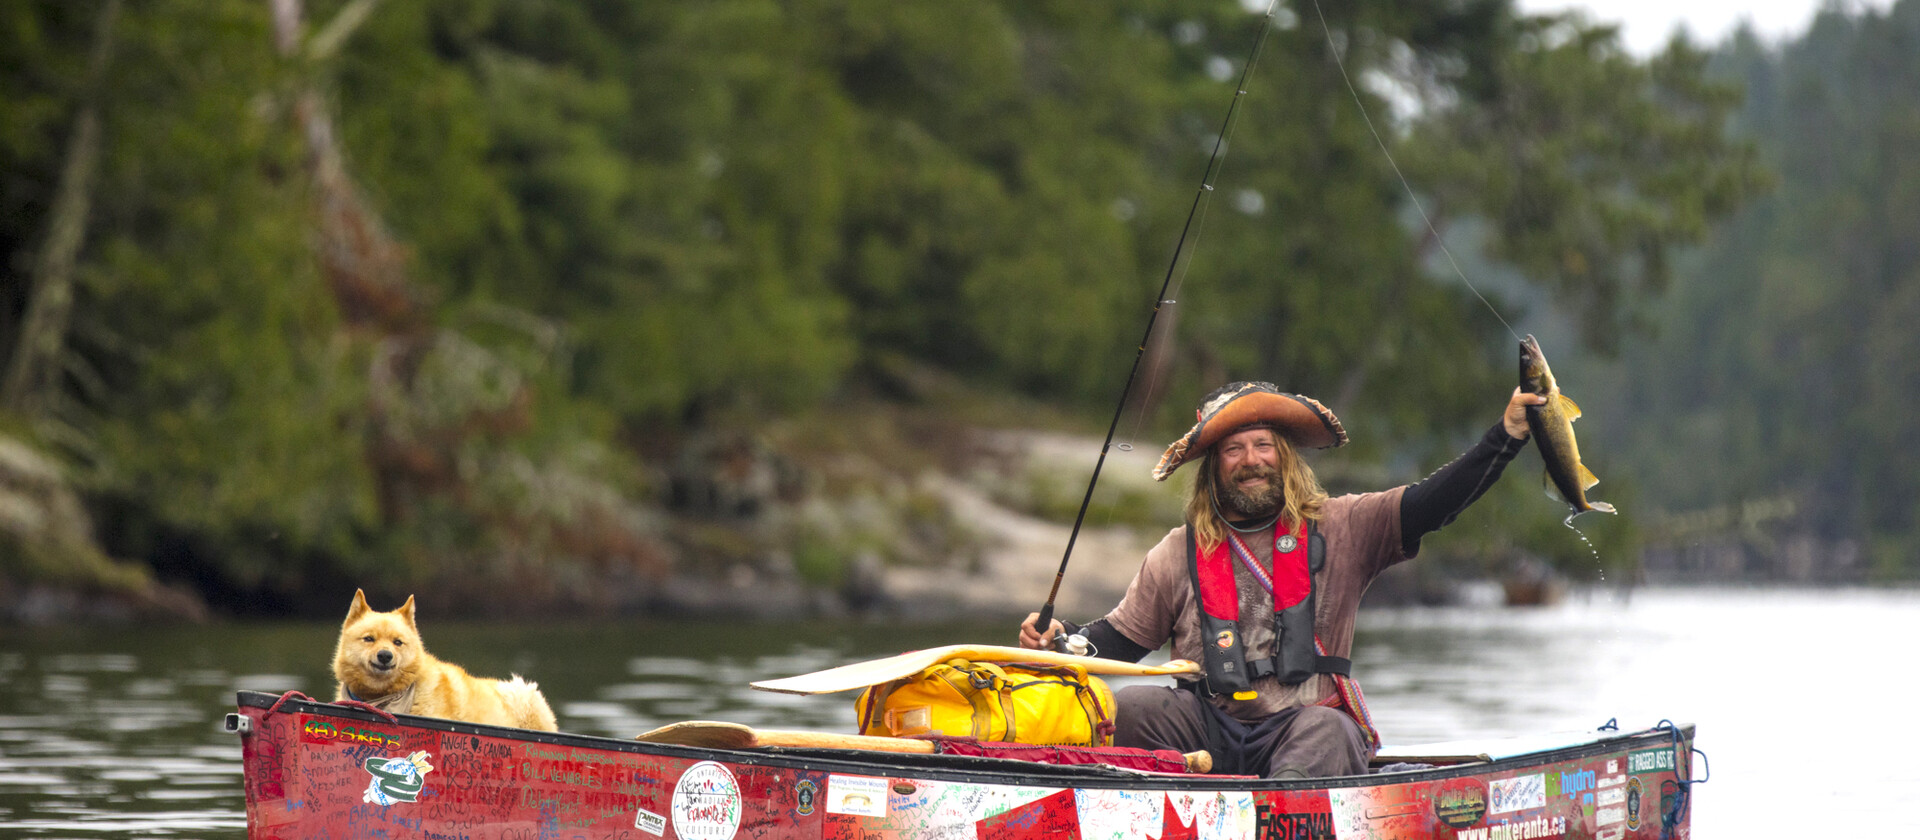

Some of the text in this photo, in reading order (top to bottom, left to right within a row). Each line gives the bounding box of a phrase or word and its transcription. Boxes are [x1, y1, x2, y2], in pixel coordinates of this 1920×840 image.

[304, 719, 338, 740] RED
[340, 726, 400, 751] SHREDS
[440, 733, 467, 751] ANGIE
[483, 741, 513, 759] CANADA
[1635, 751, 1655, 772] RAGGED
[1656, 750, 1667, 769] ASS
[522, 762, 602, 788] BILL VENABLES
[696, 769, 723, 779] ONTARIO
[830, 776, 846, 785] Healing
[849, 779, 867, 787] Invisible
[869, 780, 888, 788] Wounds
[1545, 773, 1561, 797] BC
[1561, 768, 1596, 800] hydro
[423, 787, 439, 797] Eric
[612, 781, 648, 796] OLIVER
[685, 825, 725, 835] CULTURE
[1255, 805, 1336, 840] FASTENAL
[1457, 815, 1566, 840] www.mikeranta.ca
